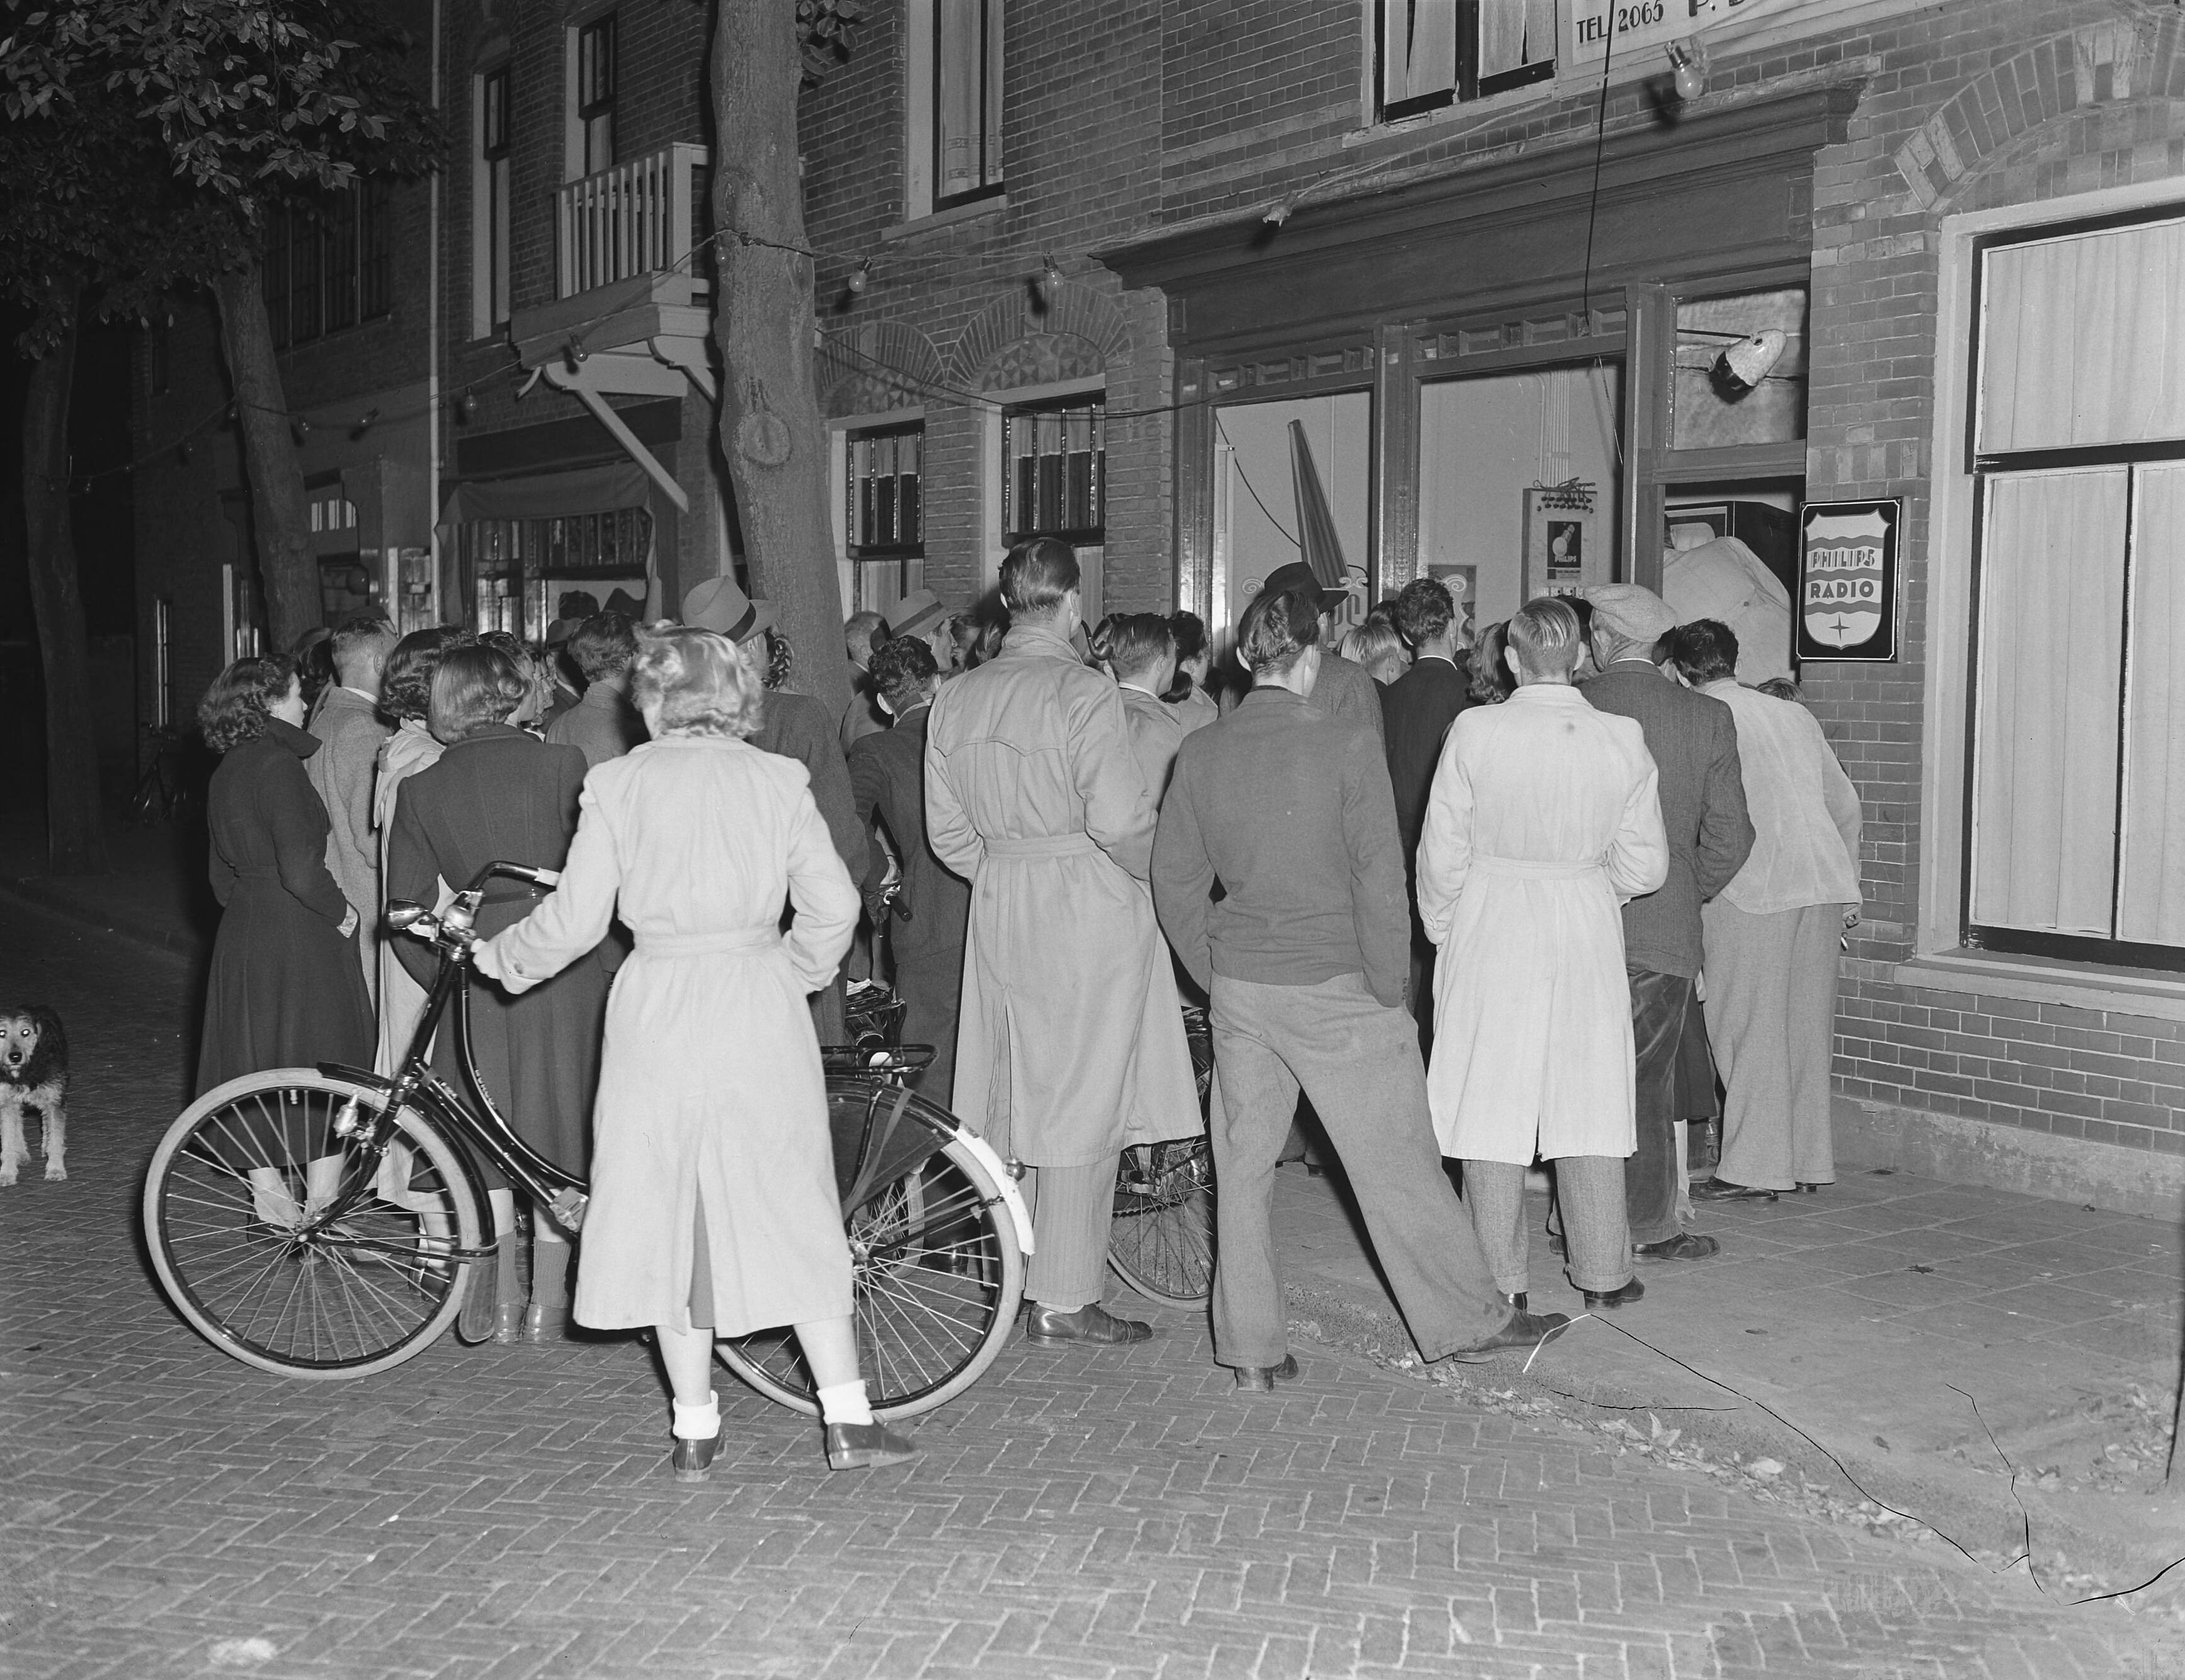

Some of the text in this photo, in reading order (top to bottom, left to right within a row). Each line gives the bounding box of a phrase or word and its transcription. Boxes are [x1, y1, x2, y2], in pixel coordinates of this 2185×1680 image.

[1618, 0, 1664, 32] 2065
[1810, 549, 1875, 568] PHILIPS
[1810, 580, 1874, 599] RADIO
